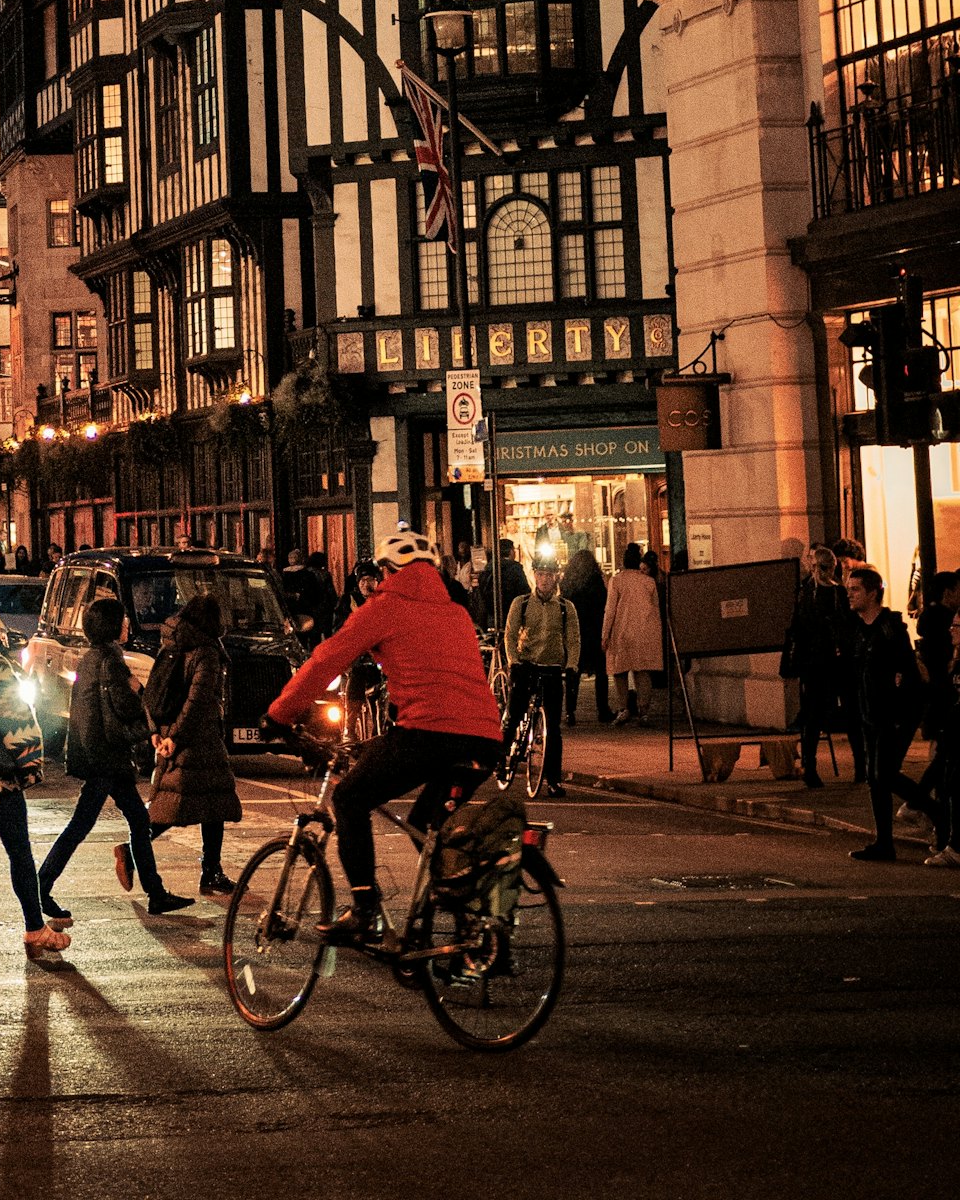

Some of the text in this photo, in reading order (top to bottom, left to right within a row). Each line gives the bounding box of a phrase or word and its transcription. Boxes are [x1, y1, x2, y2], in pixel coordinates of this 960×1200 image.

[452, 381, 474, 390] ZONE
[668, 410, 711, 427] COS
[575, 441, 617, 456] SHOP
[624, 440, 649, 454] ON
[239, 730, 259, 740] LB5
